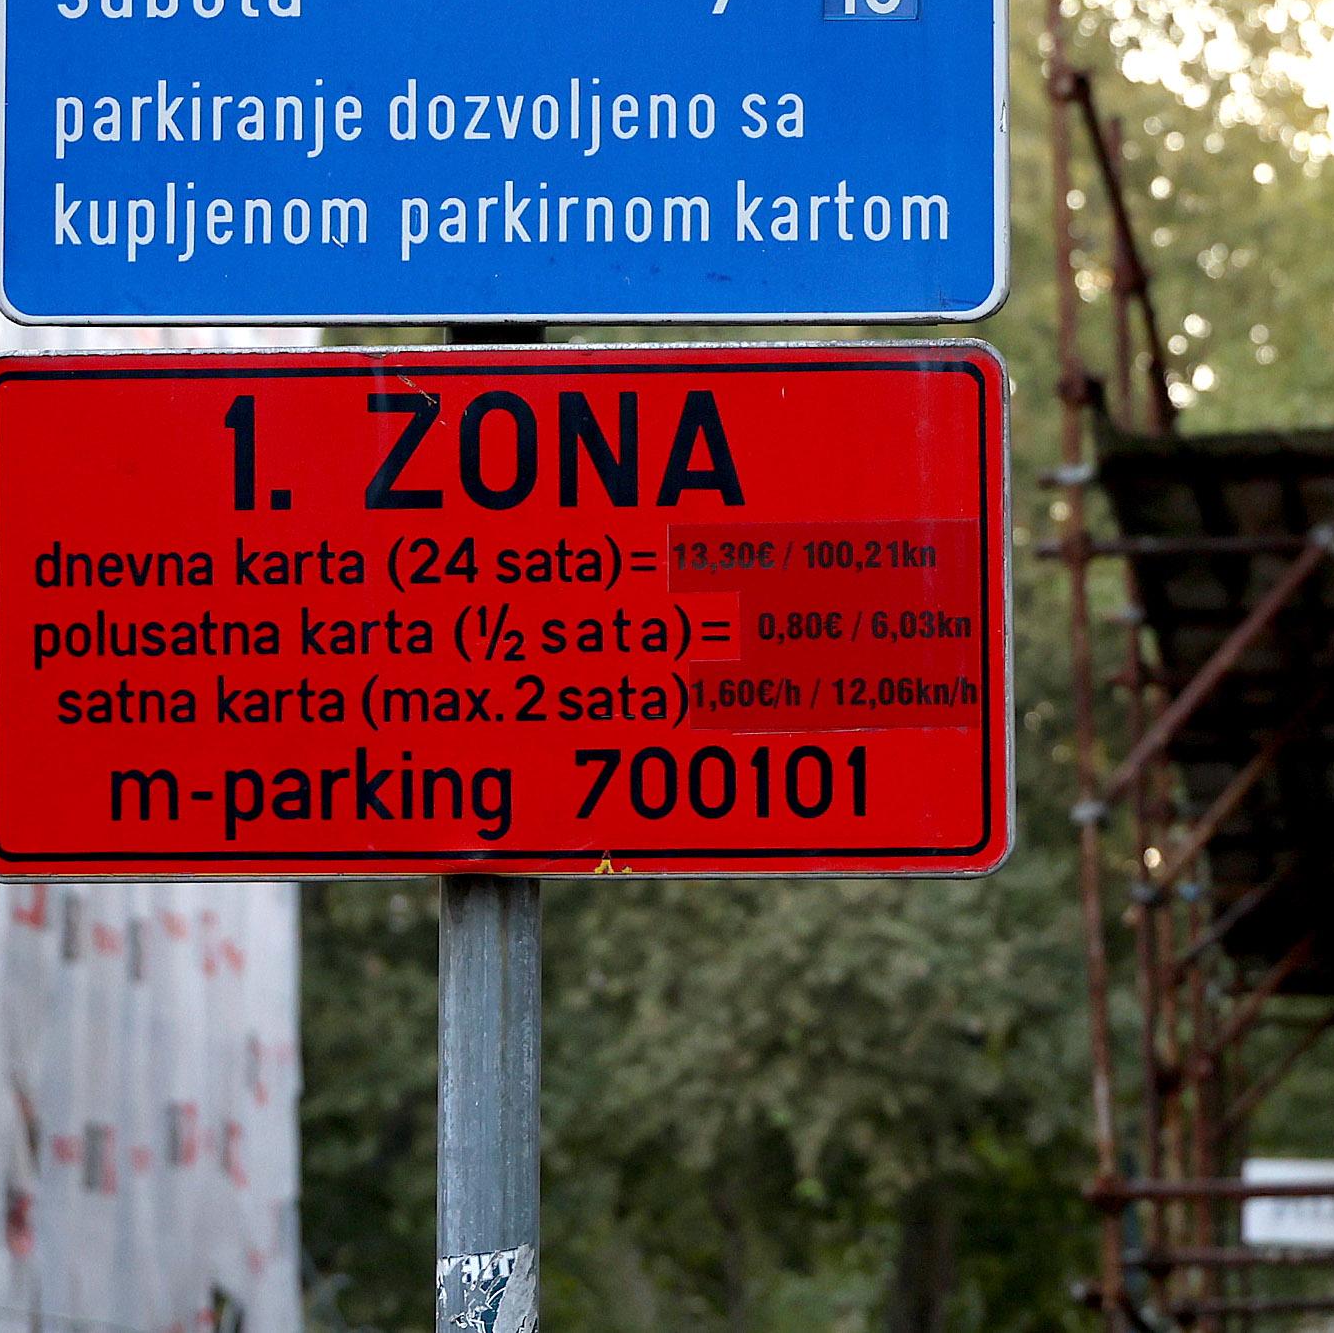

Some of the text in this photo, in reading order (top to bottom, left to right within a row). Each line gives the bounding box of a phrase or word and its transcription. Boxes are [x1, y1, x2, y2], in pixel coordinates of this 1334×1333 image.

[56, 78, 803, 158] parkiranje dozvoljeno sa
[56, 180, 947, 261] kupljenom parkirnom kartom
[225, 391, 745, 510] 1. ZONA
[36, 541, 212, 588] dnevna
[237, 538, 364, 585] karta
[388, 537, 478, 592] (24
[672, 539, 777, 575] 13,30€
[801, 539, 938, 574] 100,21kn
[34, 610, 279, 670] polusatna
[302, 607, 432, 654] karta
[757, 611, 844, 645] 0,80€
[869, 610, 973, 644] 6,03kn
[58, 680, 195, 724] satna
[218, 675, 344, 723] karta
[362, 675, 503, 730] (max.
[516, 675, 546, 721] 2
[559, 673, 689, 728] sata)
[111, 746, 866, 841] m-parking 700101
